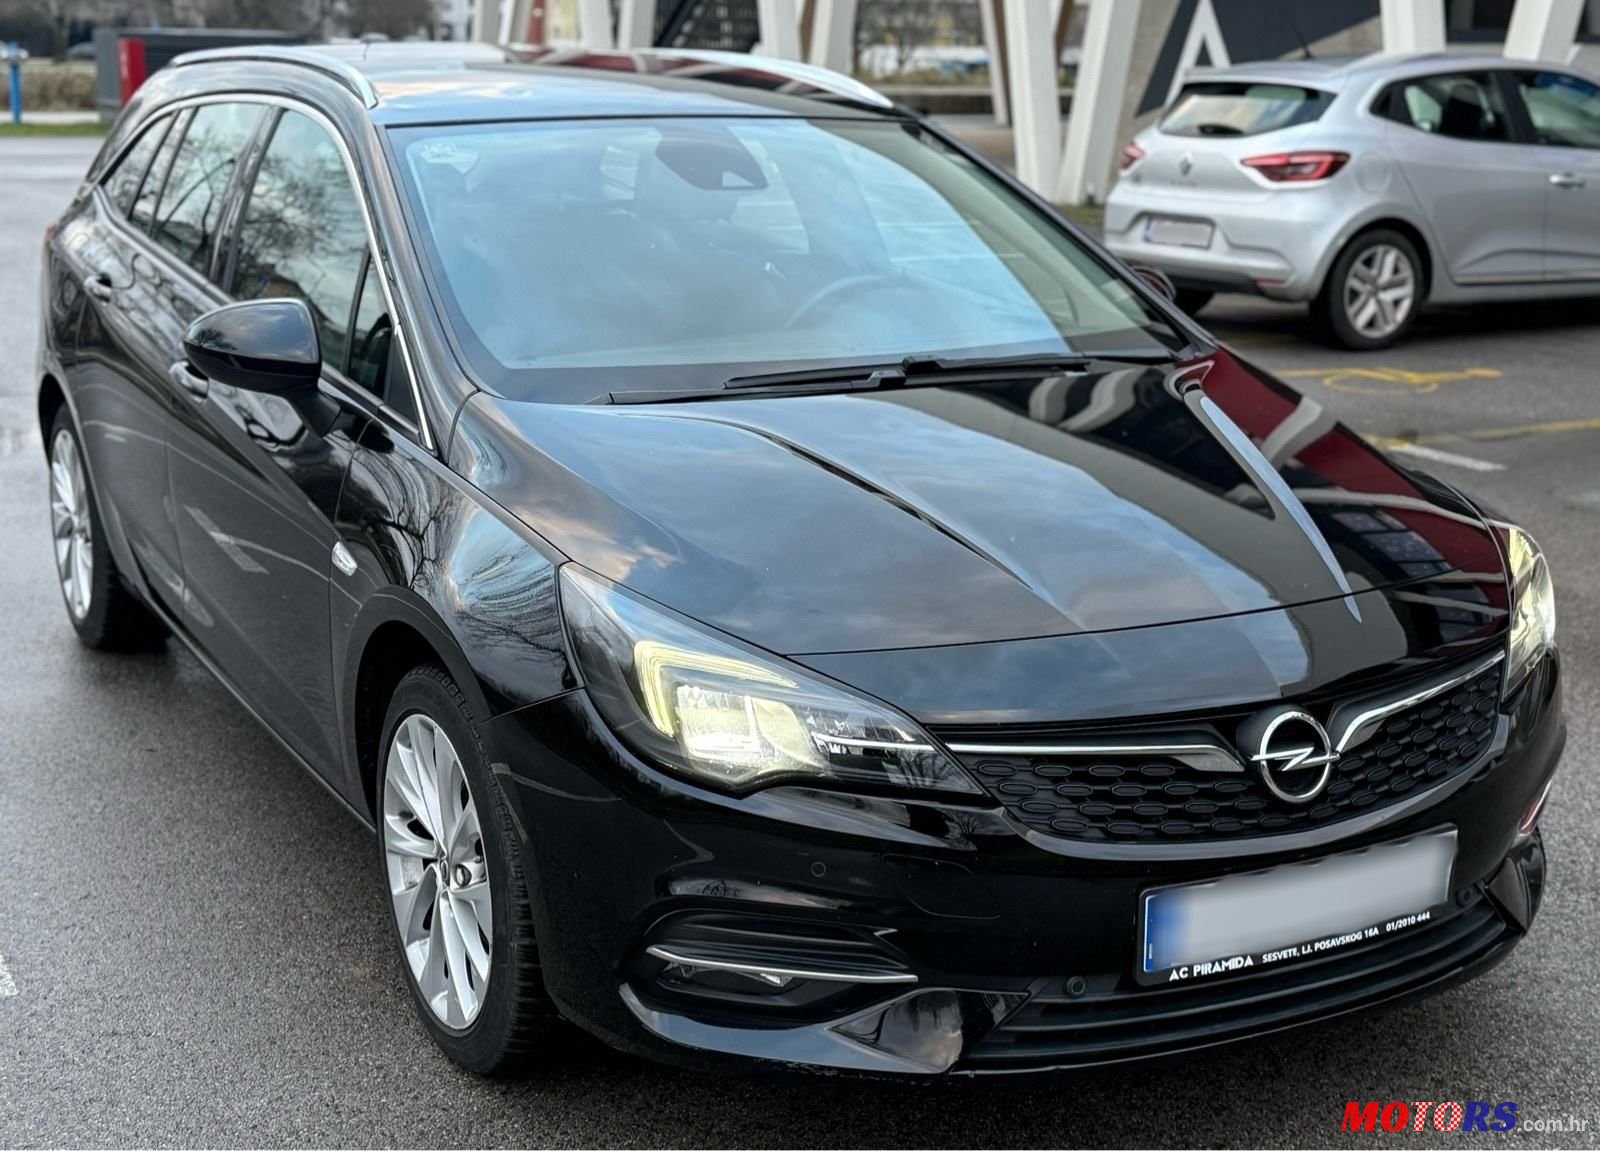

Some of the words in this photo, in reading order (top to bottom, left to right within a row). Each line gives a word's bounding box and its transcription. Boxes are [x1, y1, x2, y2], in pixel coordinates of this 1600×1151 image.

[1169, 967, 1188, 982] AC
[1193, 955, 1254, 977] PIRAMIDA
[1262, 947, 1300, 963] SESVETE,
[1314, 931, 1362, 952] POSAVSKOG
[1364, 926, 1379, 938] 16A
[1386, 915, 1416, 932] 01/2010
[1416, 911, 1431, 922] 444
